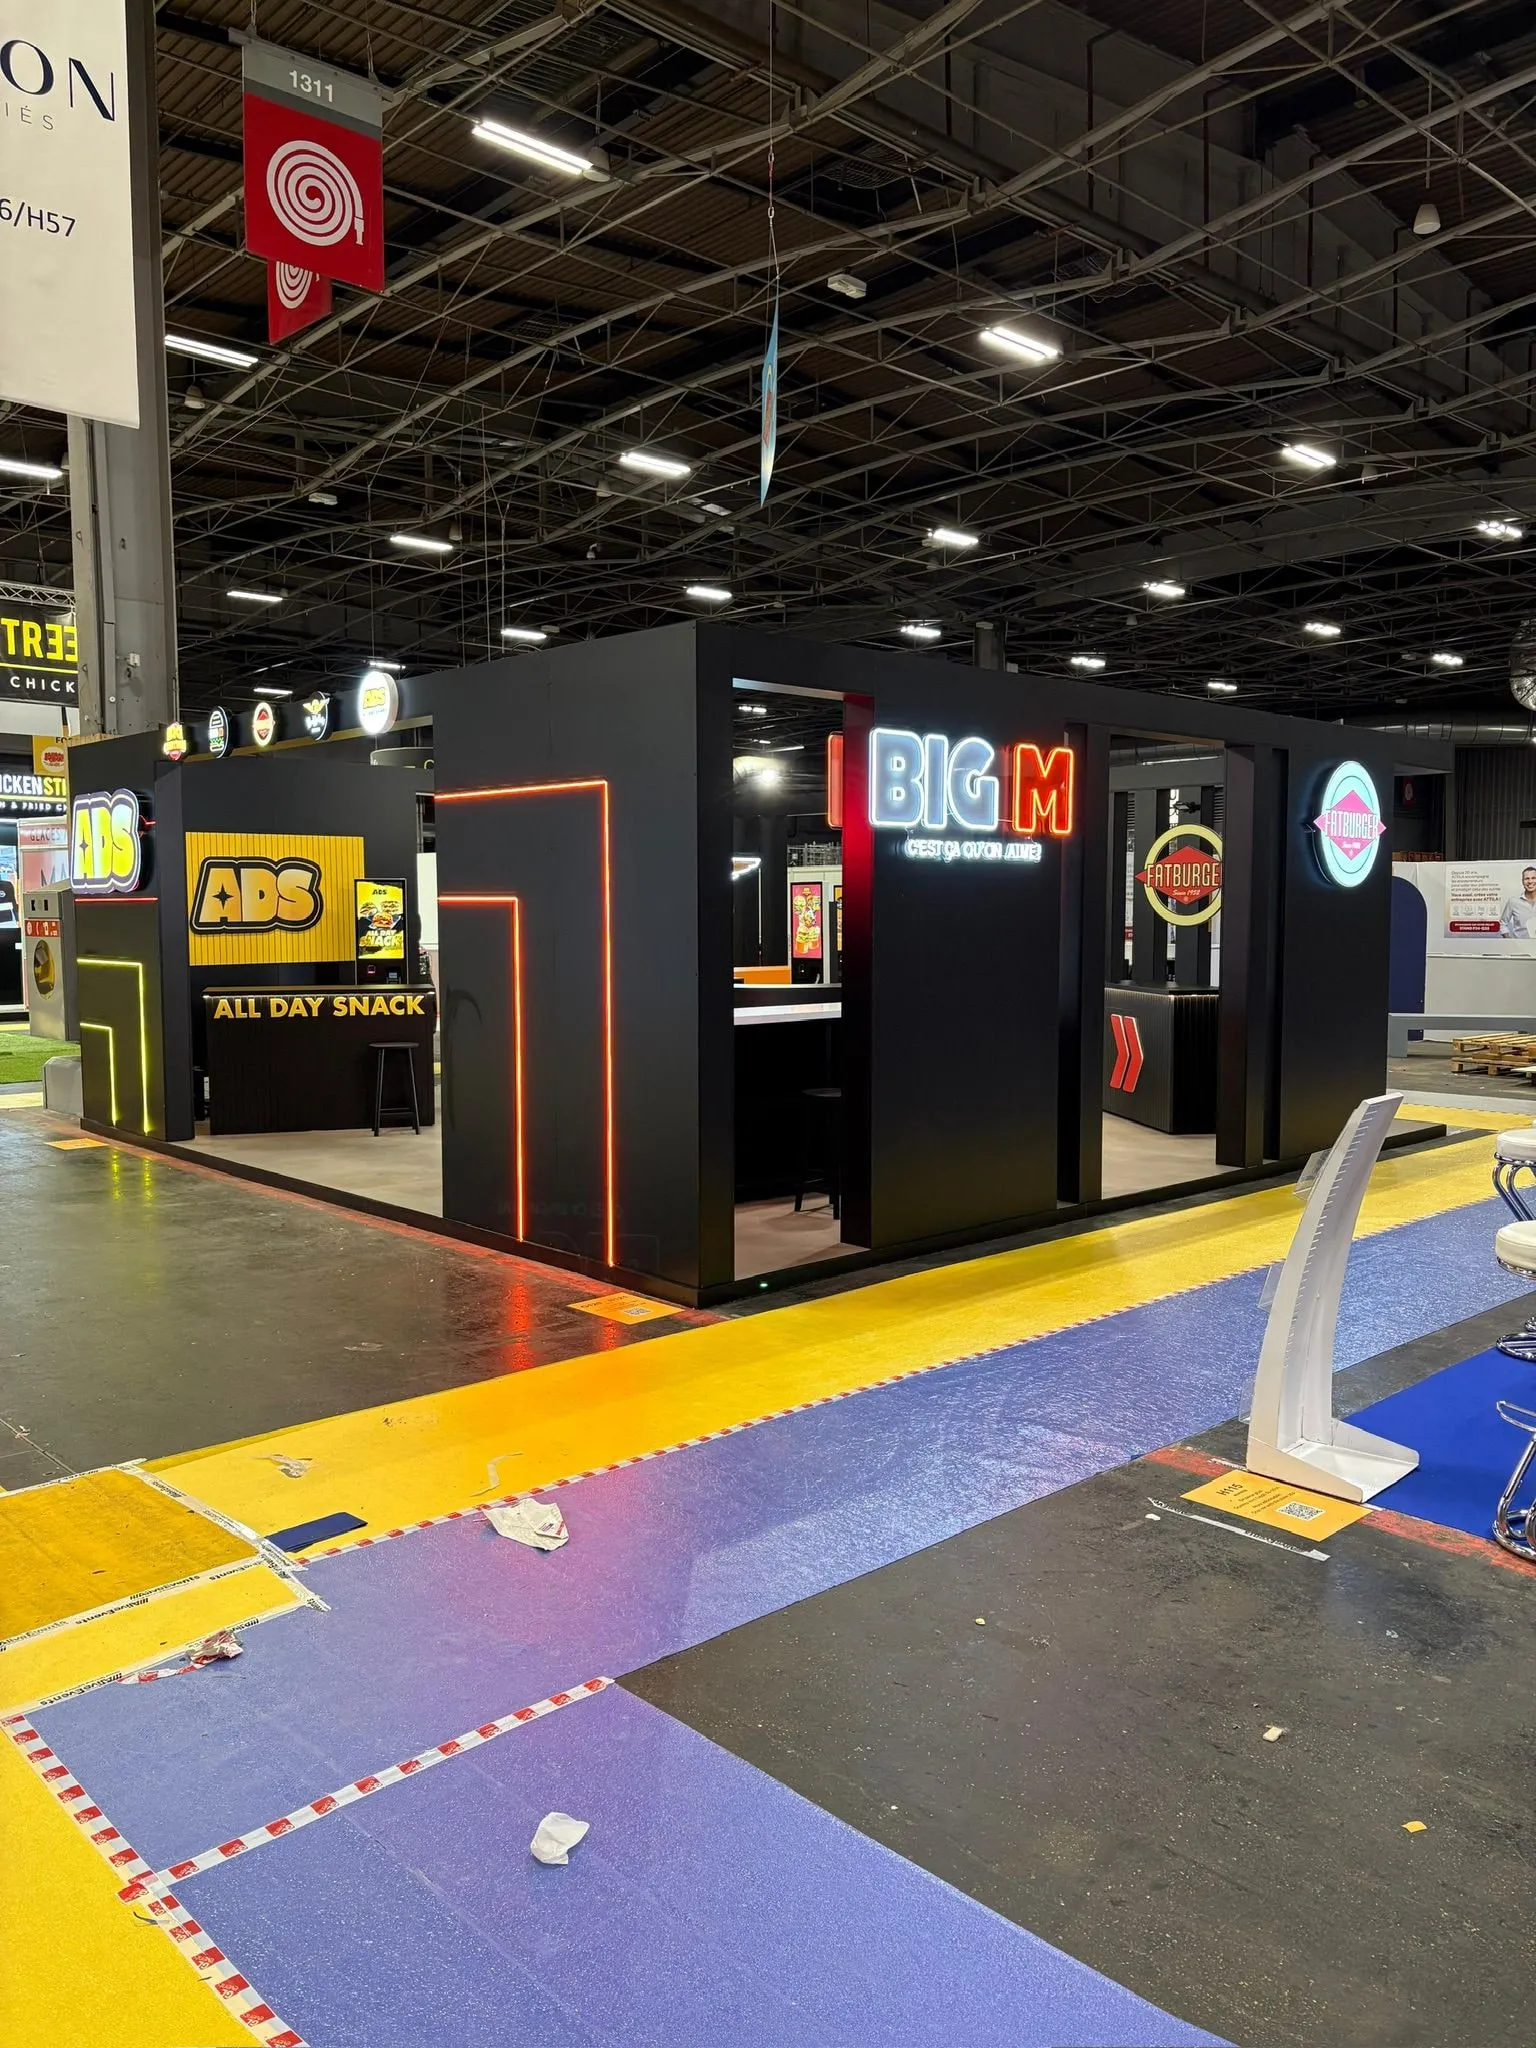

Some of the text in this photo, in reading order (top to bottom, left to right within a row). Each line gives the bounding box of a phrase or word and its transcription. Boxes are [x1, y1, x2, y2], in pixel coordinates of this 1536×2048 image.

[289, 70, 333, 103] 1311
[869, 728, 1075, 835] BIG M
[73, 803, 135, 880] ADS
[1324, 810, 1380, 840] FATBURGER
[196, 864, 319, 927] ADS
[213, 995, 425, 1019] ALL DAY SNACK
[1216, 1483, 1244, 1496] H115
